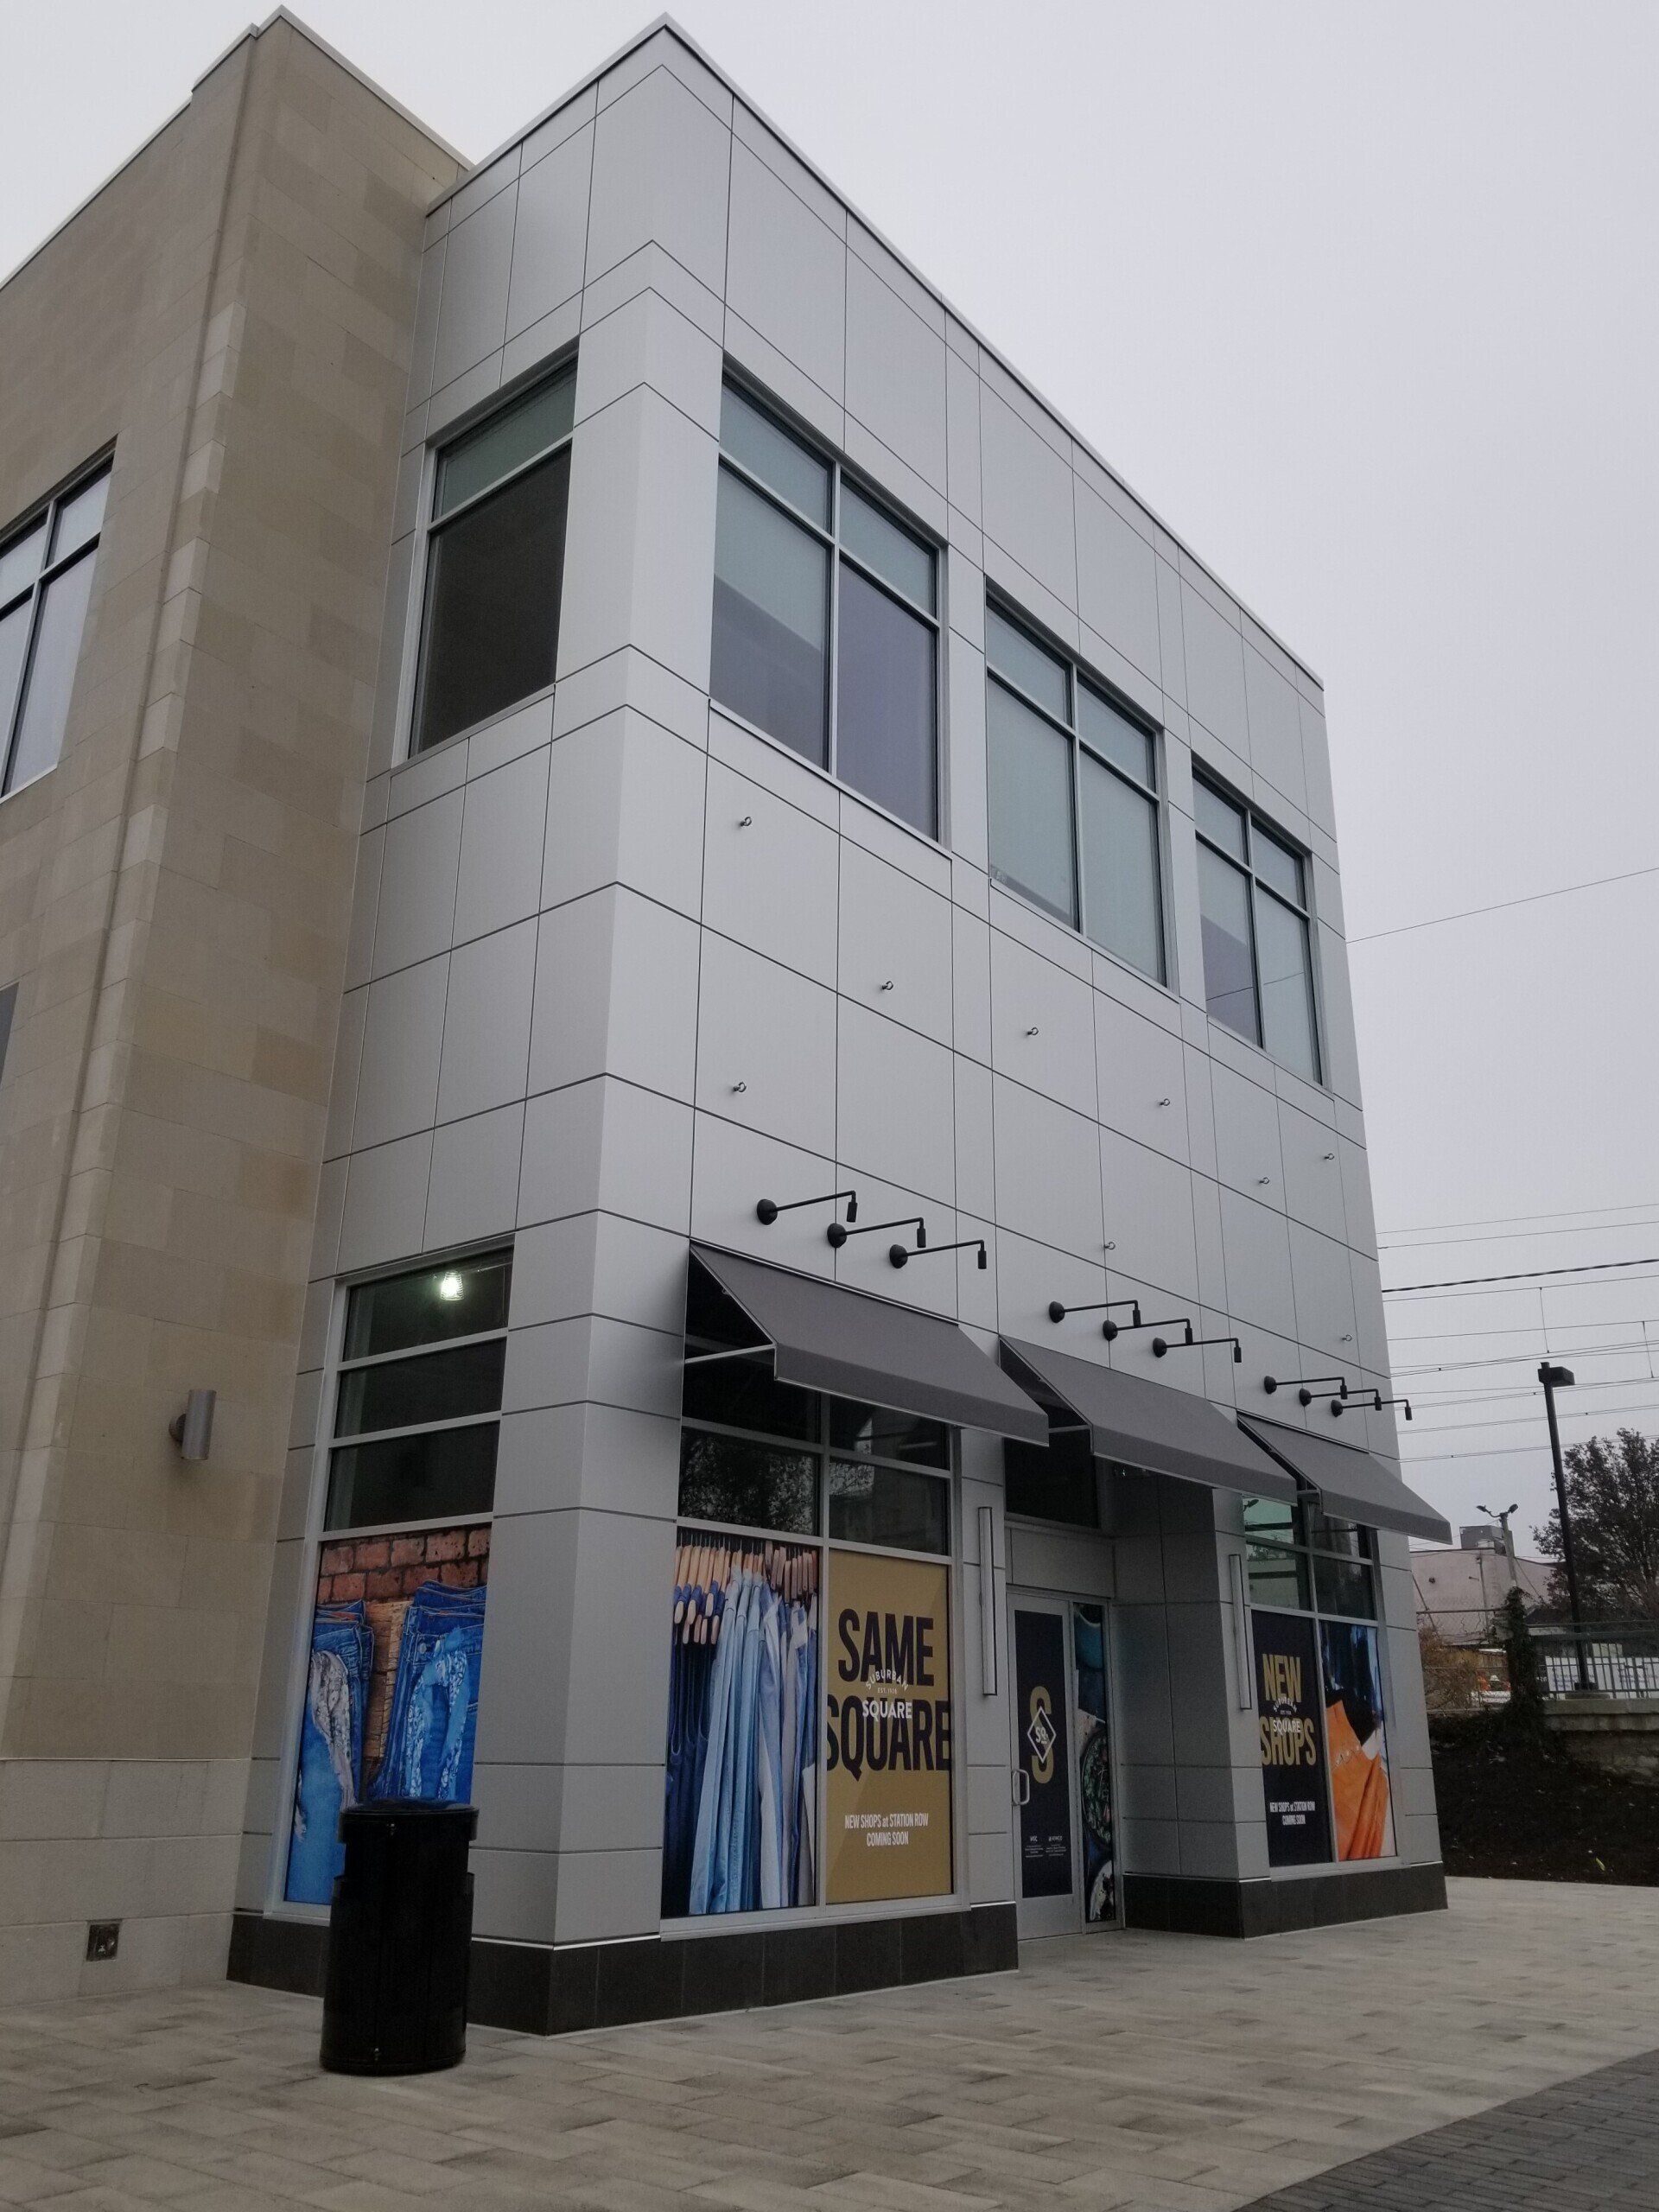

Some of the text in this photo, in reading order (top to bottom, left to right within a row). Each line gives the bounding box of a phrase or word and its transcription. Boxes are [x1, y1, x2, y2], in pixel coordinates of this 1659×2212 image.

[838, 1608, 934, 1687] SAME
[866, 1669, 908, 1691] SUBURBAN
[1262, 1654, 1301, 1702] NEW
[862, 1700, 912, 1721] SQUARE
[827, 1694, 950, 1780] SQUARE
[1273, 1719, 1300, 1735] SQUARE
[1260, 1716, 1317, 1765] SHOPS
[845, 1813, 929, 1828] NEW SHOPS at STATION ROW
[867, 1832, 909, 1847] COMING SOON
